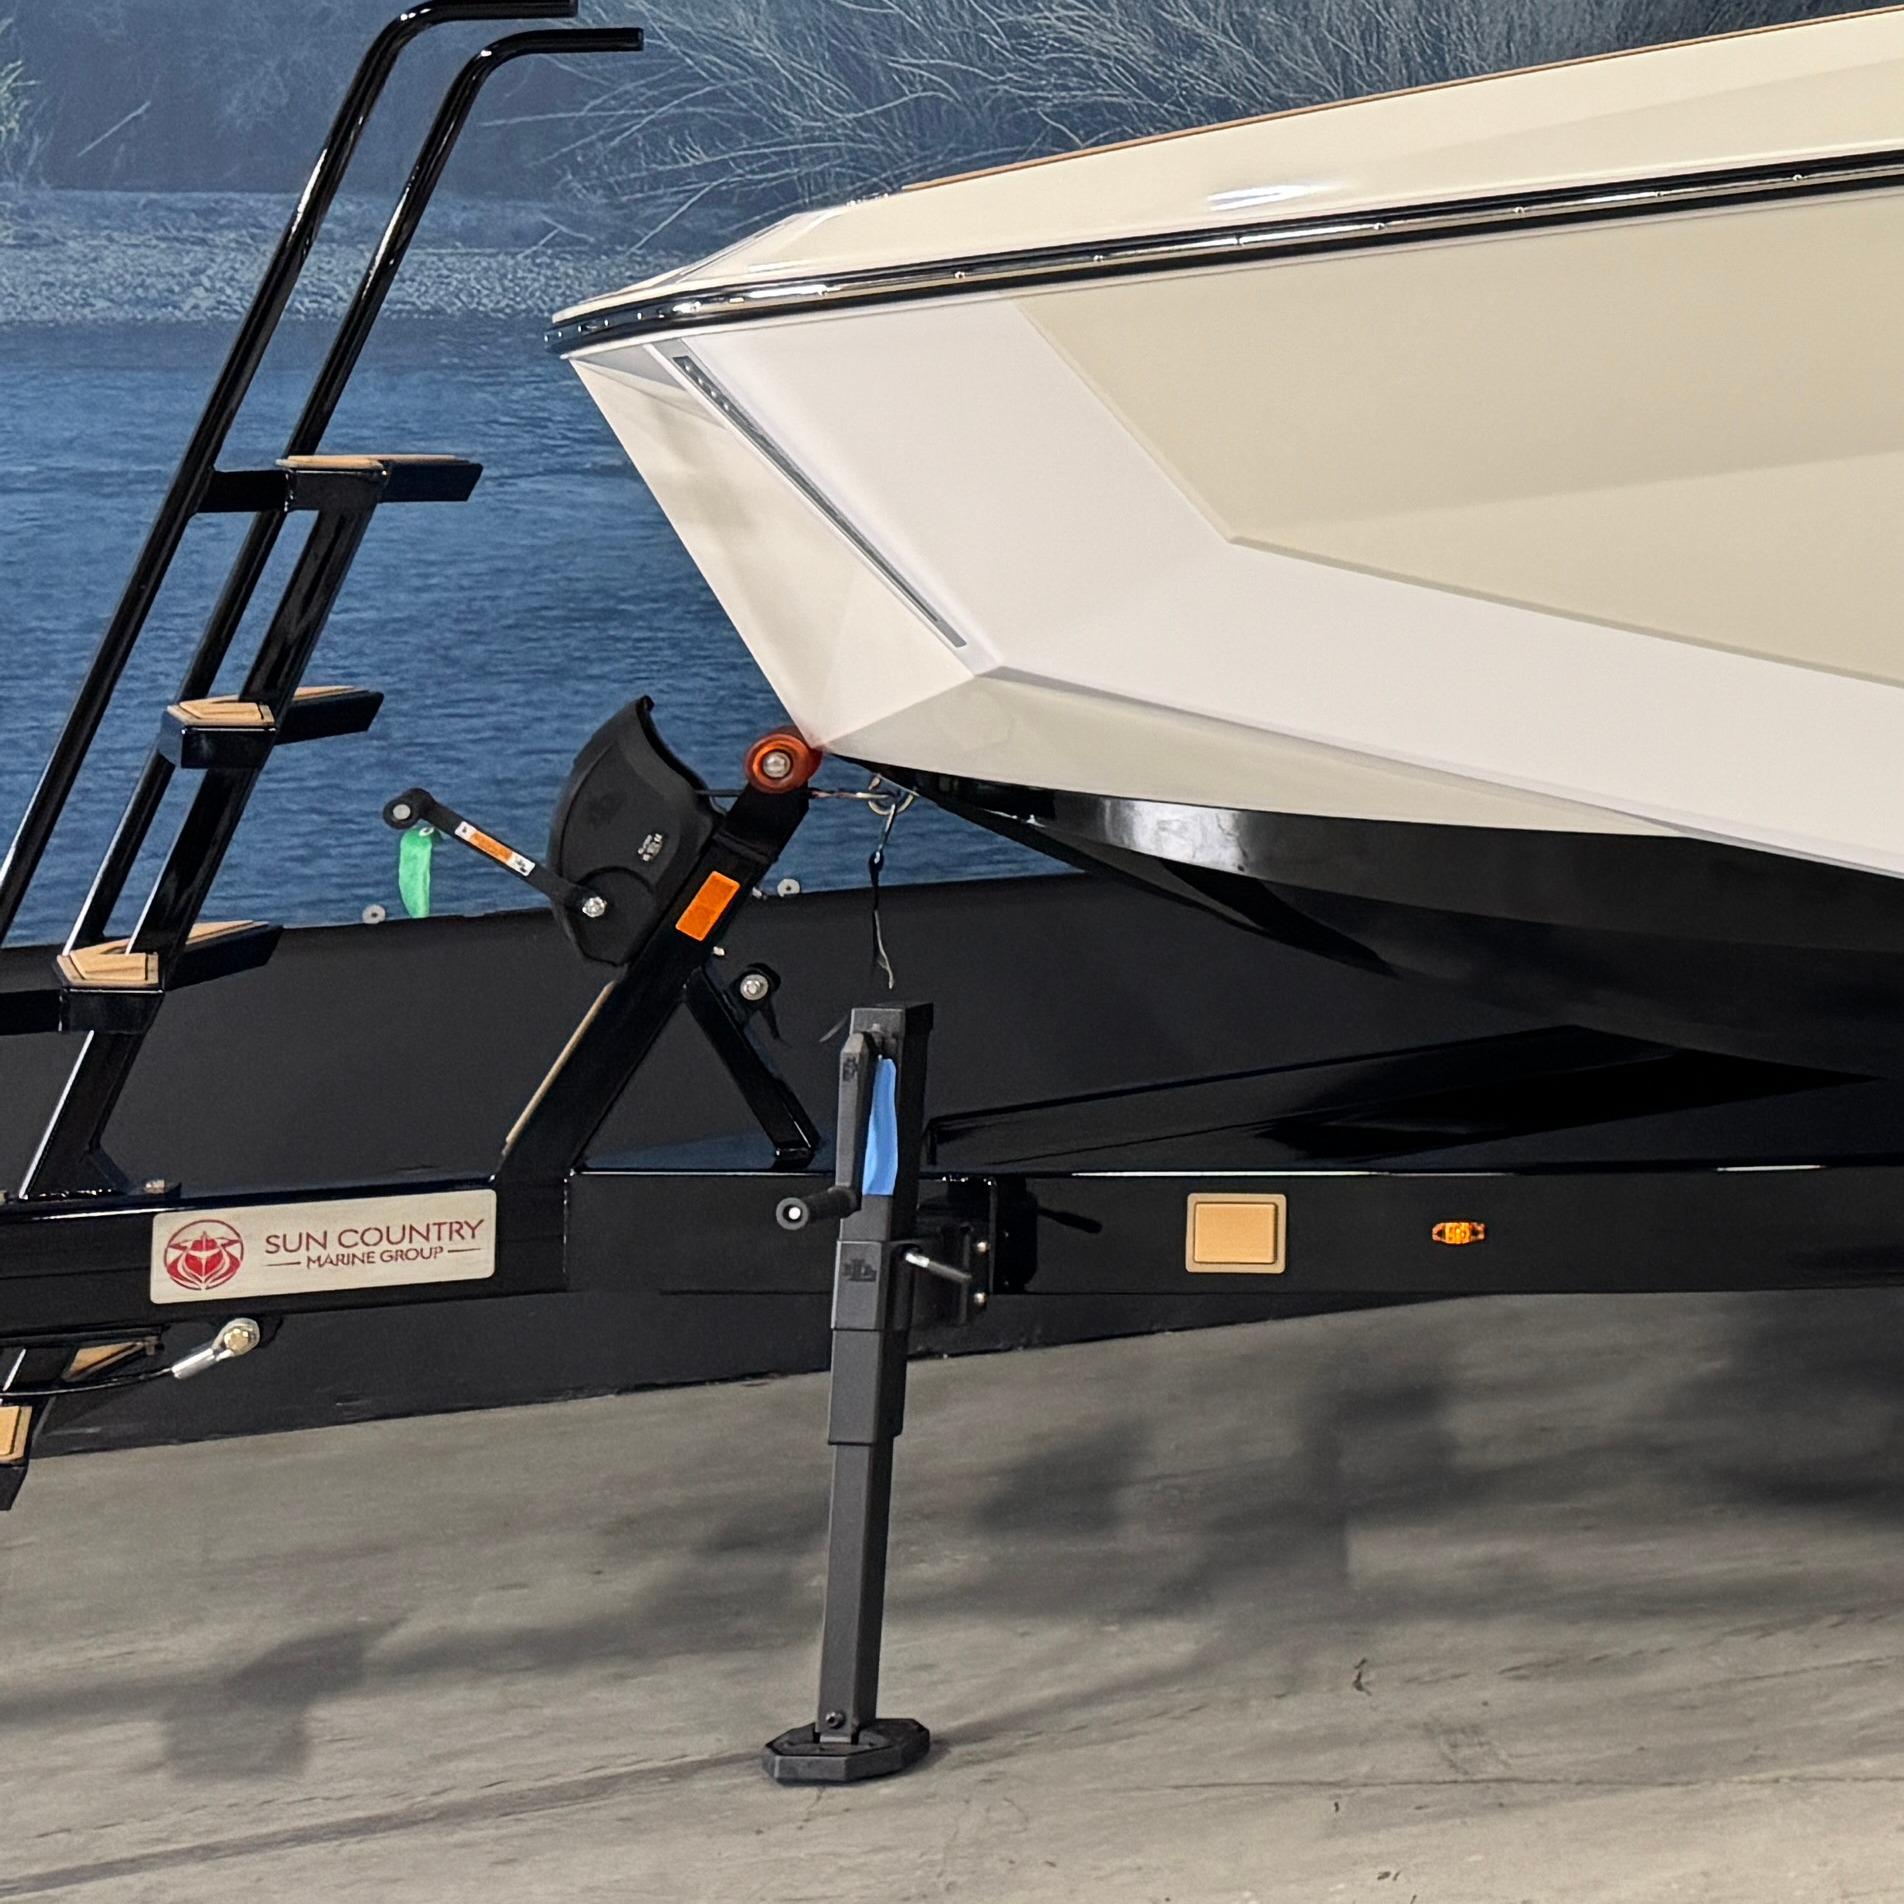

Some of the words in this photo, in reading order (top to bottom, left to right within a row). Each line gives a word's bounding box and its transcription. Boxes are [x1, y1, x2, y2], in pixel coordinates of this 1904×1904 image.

[265, 1231, 328, 1255] SUN
[338, 1218, 485, 1249] COUNTRY
[306, 1250, 376, 1270] MARINE
[380, 1245, 444, 1263] GROUP
